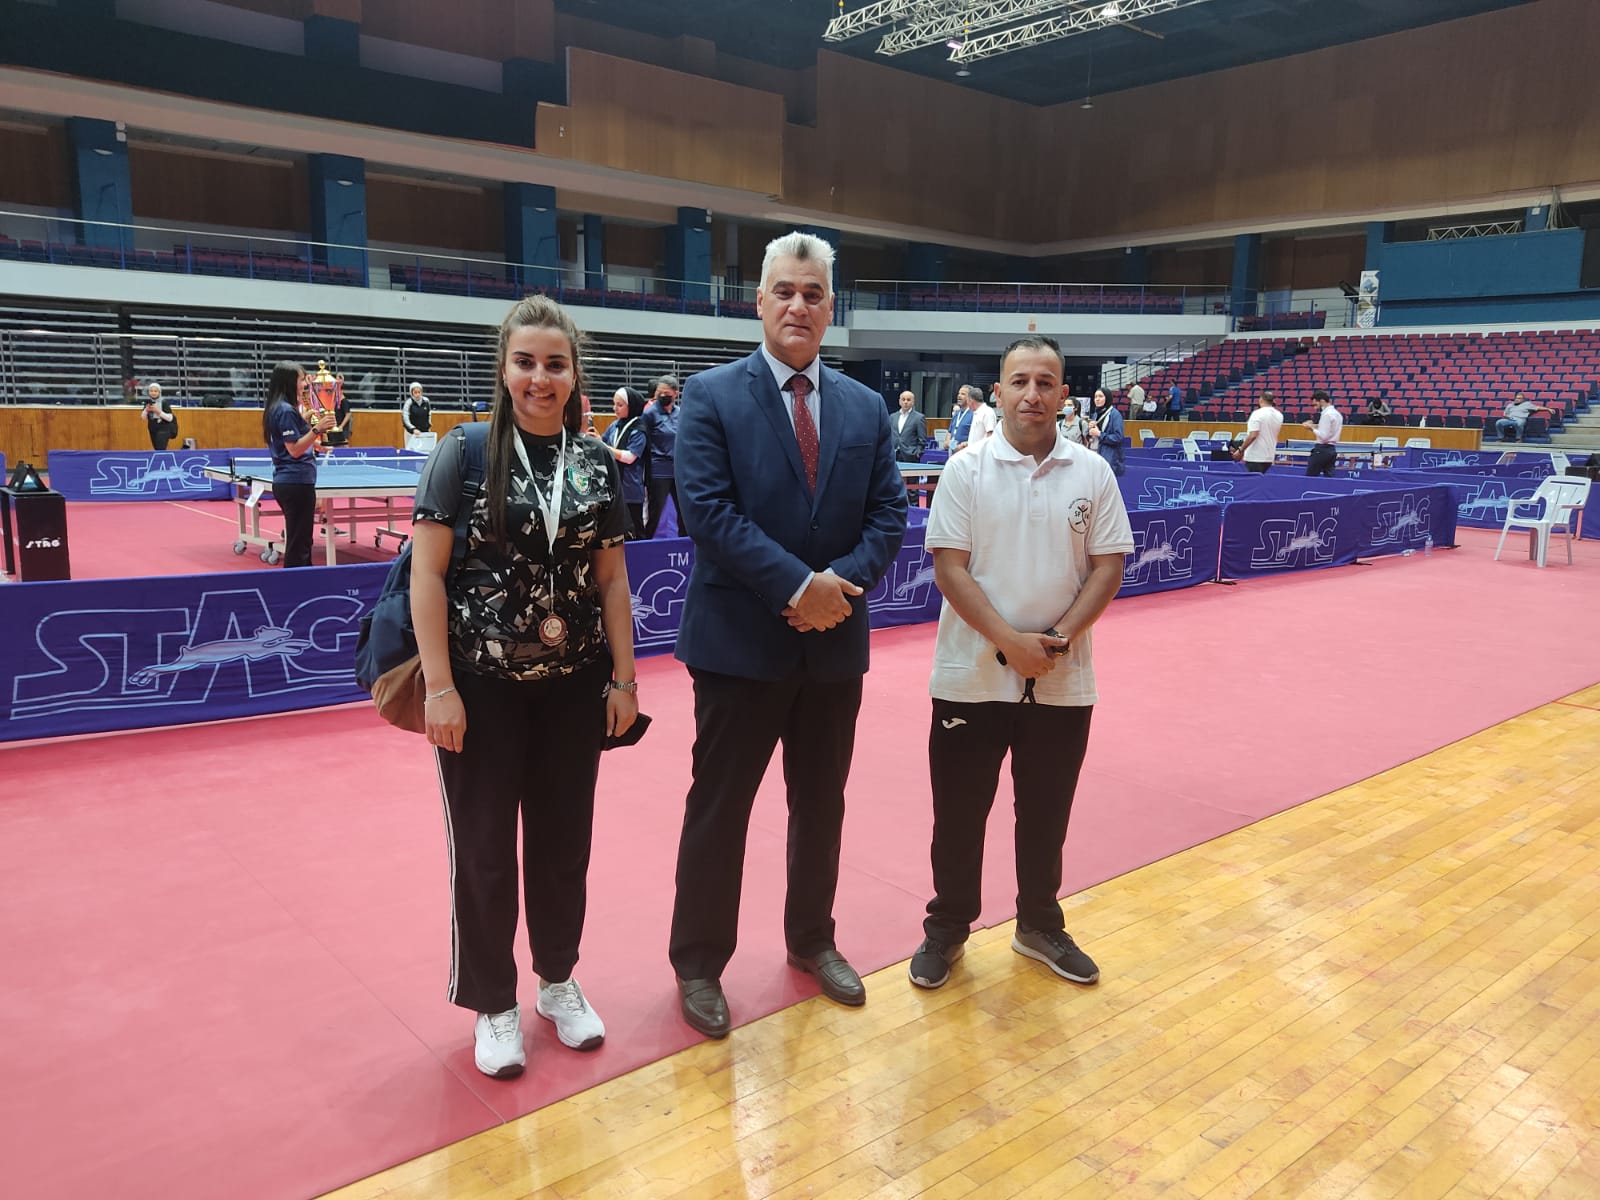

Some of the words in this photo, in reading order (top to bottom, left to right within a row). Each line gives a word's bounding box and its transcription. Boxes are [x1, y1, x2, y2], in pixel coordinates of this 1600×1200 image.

[90, 452, 212, 495] STAG
[1138, 475, 1235, 511] STAG
[1348, 470, 1360, 478] TM
[1250, 511, 1339, 569] STAG
[1331, 506, 1340, 516] TM
[1370, 493, 1431, 547] STAG
[25, 538, 60, 549] STAG
[668, 552, 689, 567] TM
[1119, 519, 1194, 588] TAG
[1184, 513, 1195, 525] TM
[9, 588, 366, 720] STAG
[346, 588, 359, 596] TM
